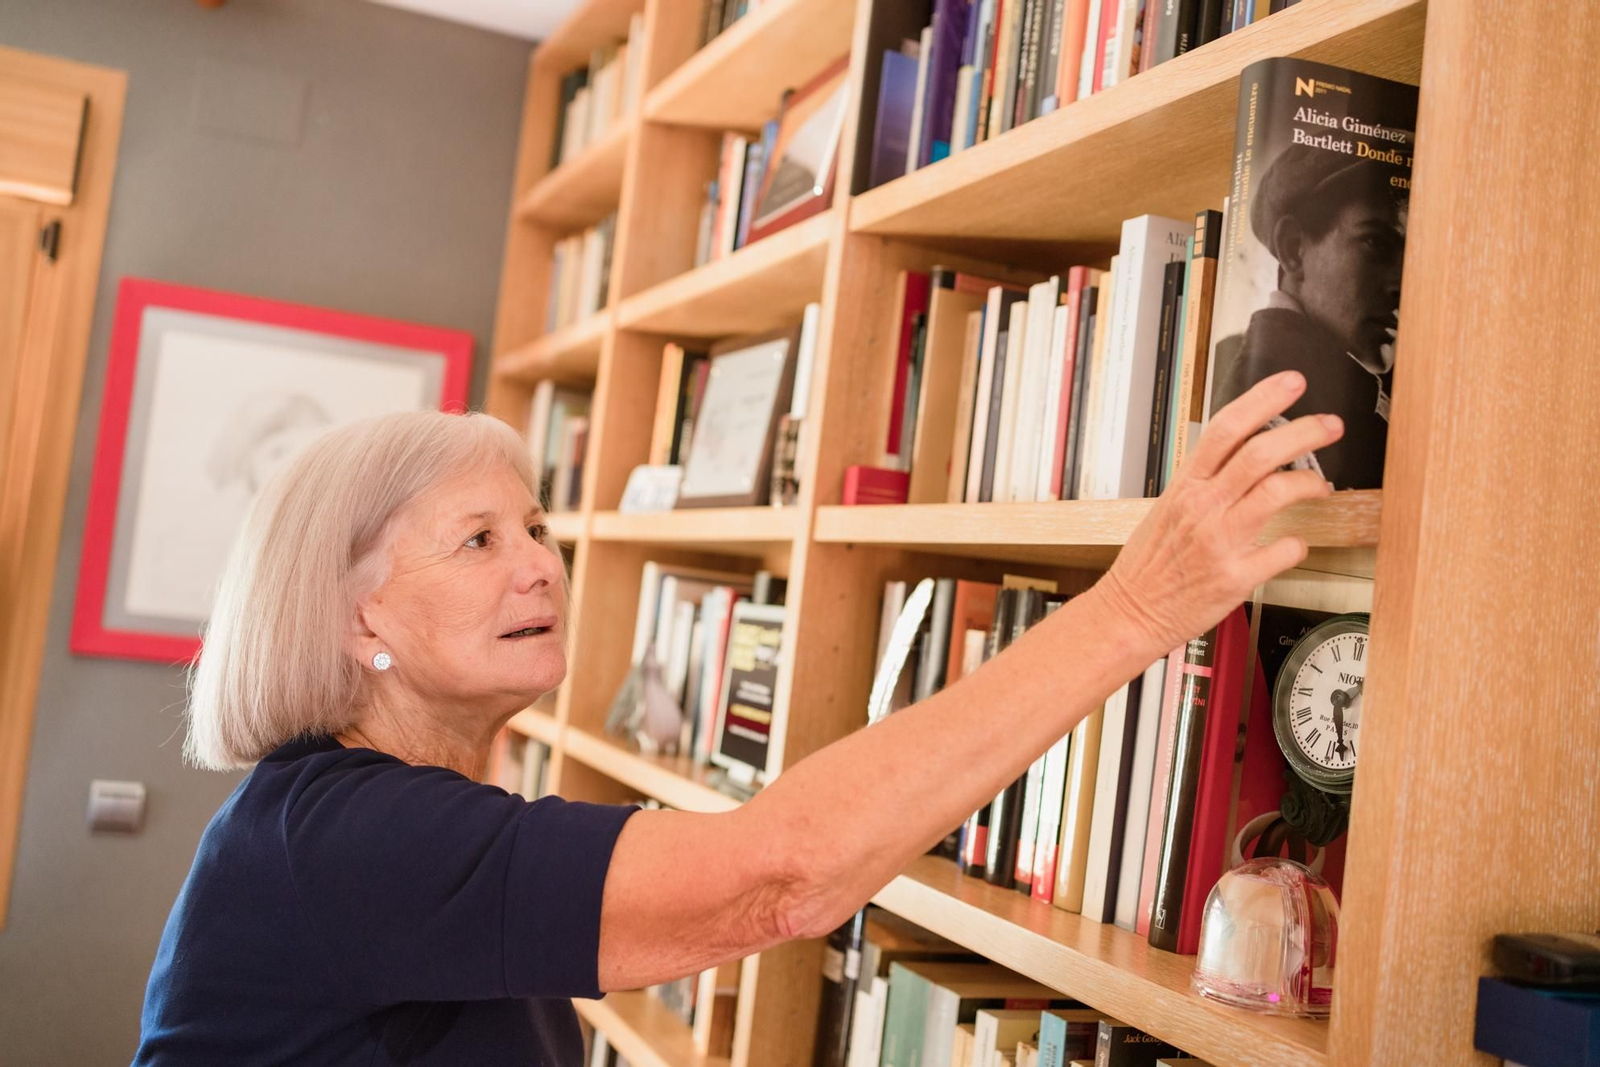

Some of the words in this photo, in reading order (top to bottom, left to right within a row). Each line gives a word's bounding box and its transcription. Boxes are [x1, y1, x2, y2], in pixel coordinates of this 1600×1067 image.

[1295, 76, 1315, 98] N
[1246, 81, 1260, 147] encuentre
[1293, 106, 1338, 129] Alicia
[1342, 116, 1406, 144] Giménez
[1292, 128, 1353, 154] Bartlett
[1356, 141, 1403, 166] Donde
[1231, 151, 1243, 204] Bartlett
[1241, 163, 1252, 201] nadie
[1226, 204, 1240, 263] Giménez
[1235, 203, 1247, 246] Donde
[1176, 425, 1185, 459] QUARTO
[1325, 724, 1348, 736] PAS
[1123, 1033, 1141, 1044] Jack
